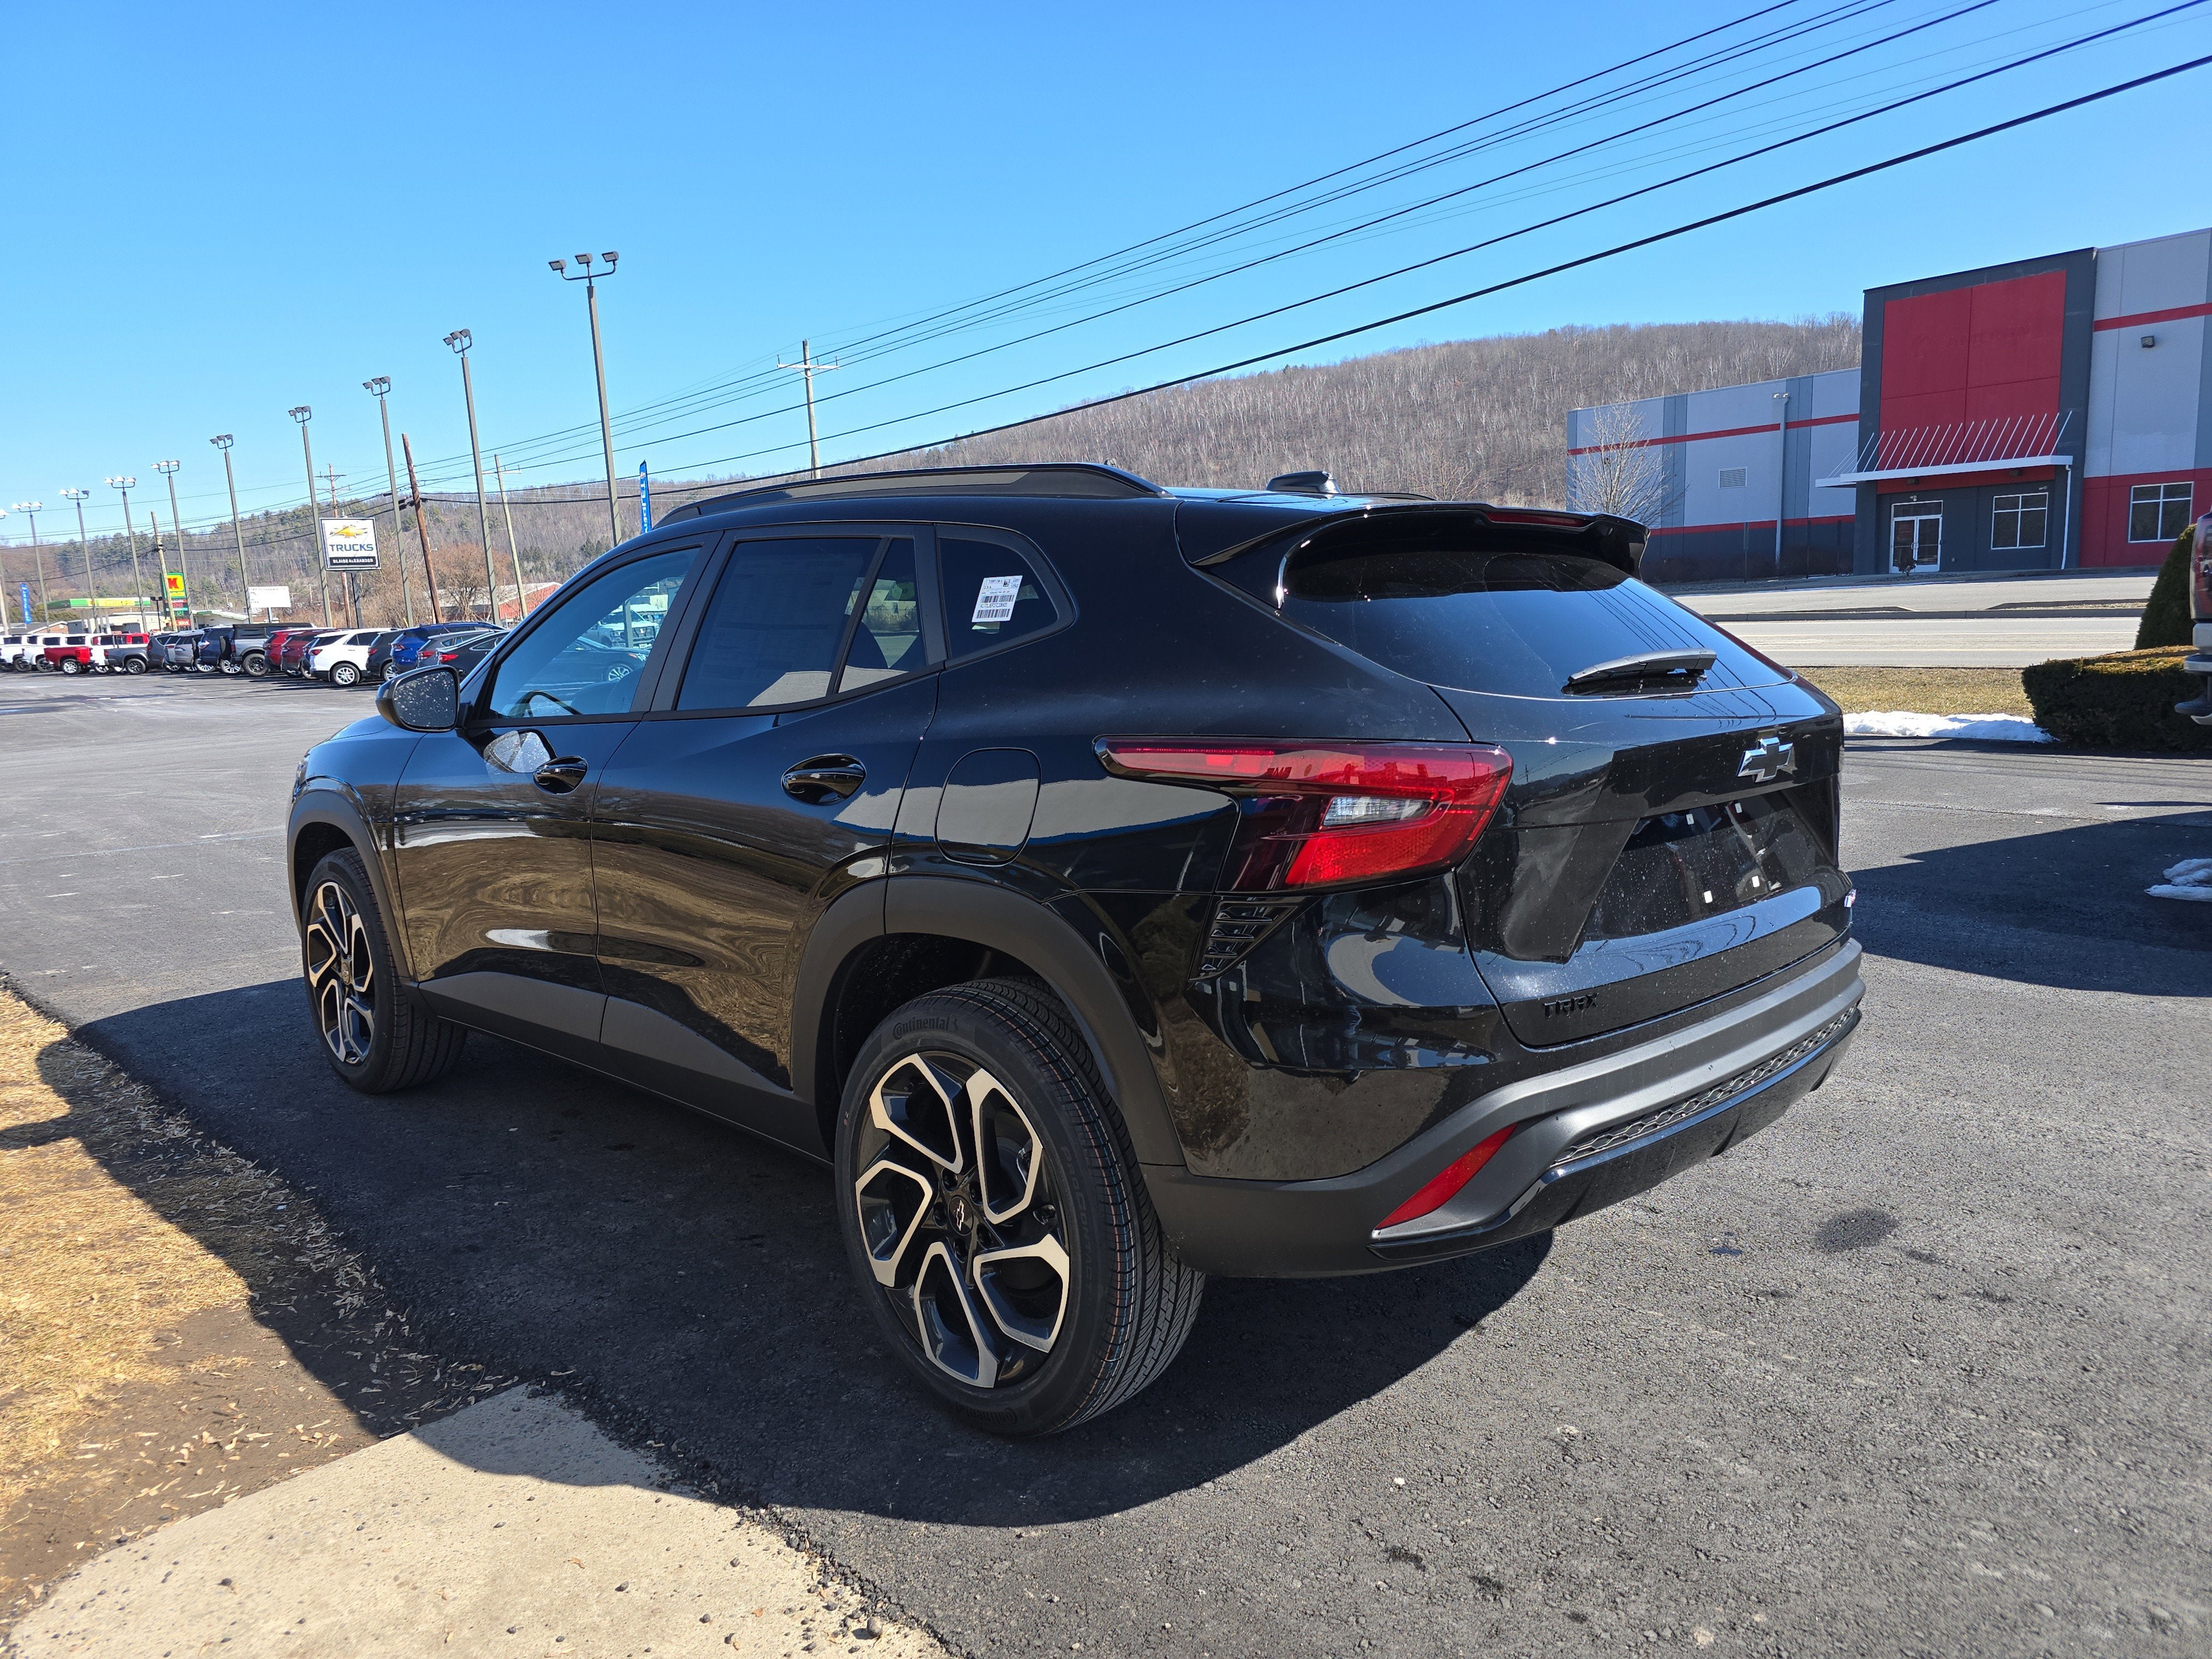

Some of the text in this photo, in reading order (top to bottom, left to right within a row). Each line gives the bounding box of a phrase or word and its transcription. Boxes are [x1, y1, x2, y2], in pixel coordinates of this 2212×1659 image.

[168, 577, 179, 589] K
[1542, 992, 1599, 1017] TRAX
[892, 1016, 950, 1040] Continental
